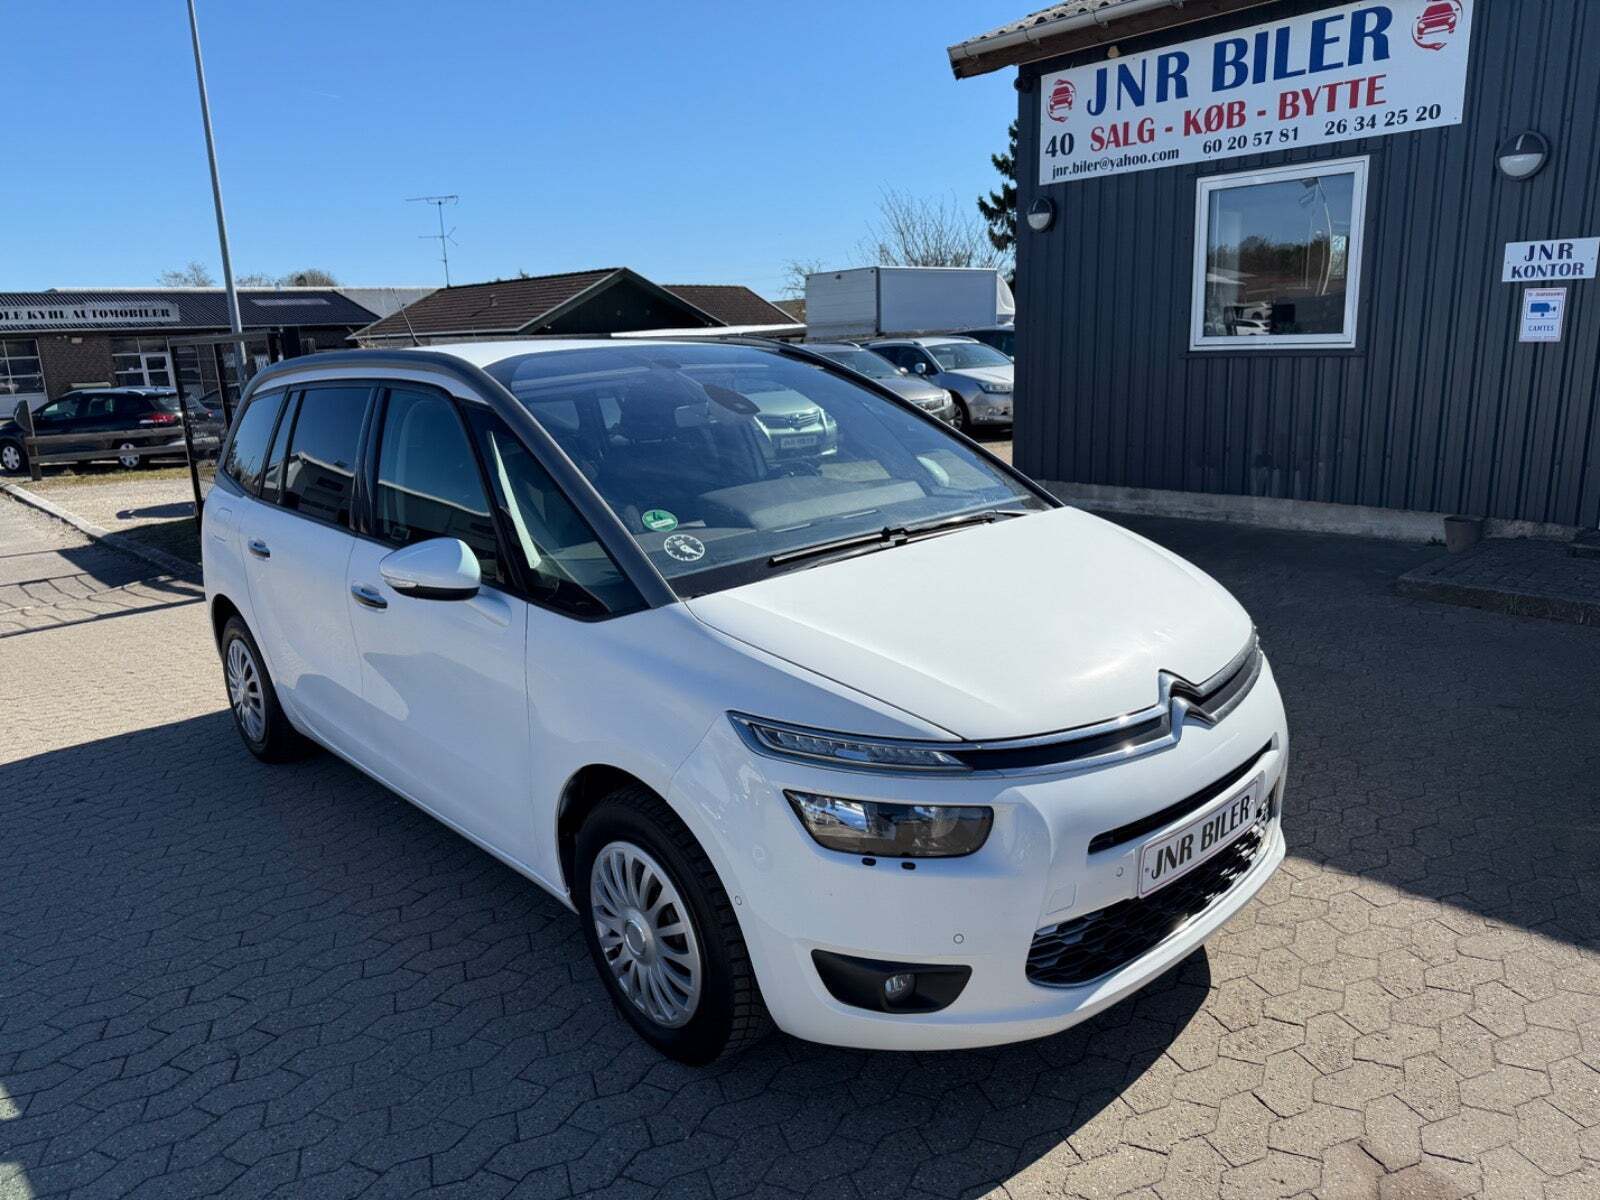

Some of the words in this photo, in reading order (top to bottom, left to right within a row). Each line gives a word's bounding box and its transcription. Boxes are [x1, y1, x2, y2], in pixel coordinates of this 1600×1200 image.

[1086, 51, 1190, 116] JNR
[1212, 6, 1393, 92] BILER
[1090, 117, 1155, 152] SALG
[1184, 100, 1246, 137] KØB
[1278, 74, 1387, 121] BYTTE
[1324, 118, 1347, 136] 26
[1353, 114, 1376, 132] 34
[1384, 109, 1408, 127] 25
[1415, 103, 1441, 122] 20
[1045, 132, 1074, 158] 40
[1202, 139, 1222, 154] 60
[1226, 134, 1248, 151] 20
[1252, 130, 1272, 147] 57
[1279, 126, 1299, 142] 81
[1052, 147, 1180, 179] jnr.biler@yahoo.com
[1524, 242, 1574, 261] JNR
[1511, 262, 1585, 279] KONTOR
[73, 307, 171, 320] AUTOMOBILER
[1151, 833, 1194, 880] JNR
[1200, 795, 1250, 852] BILER
